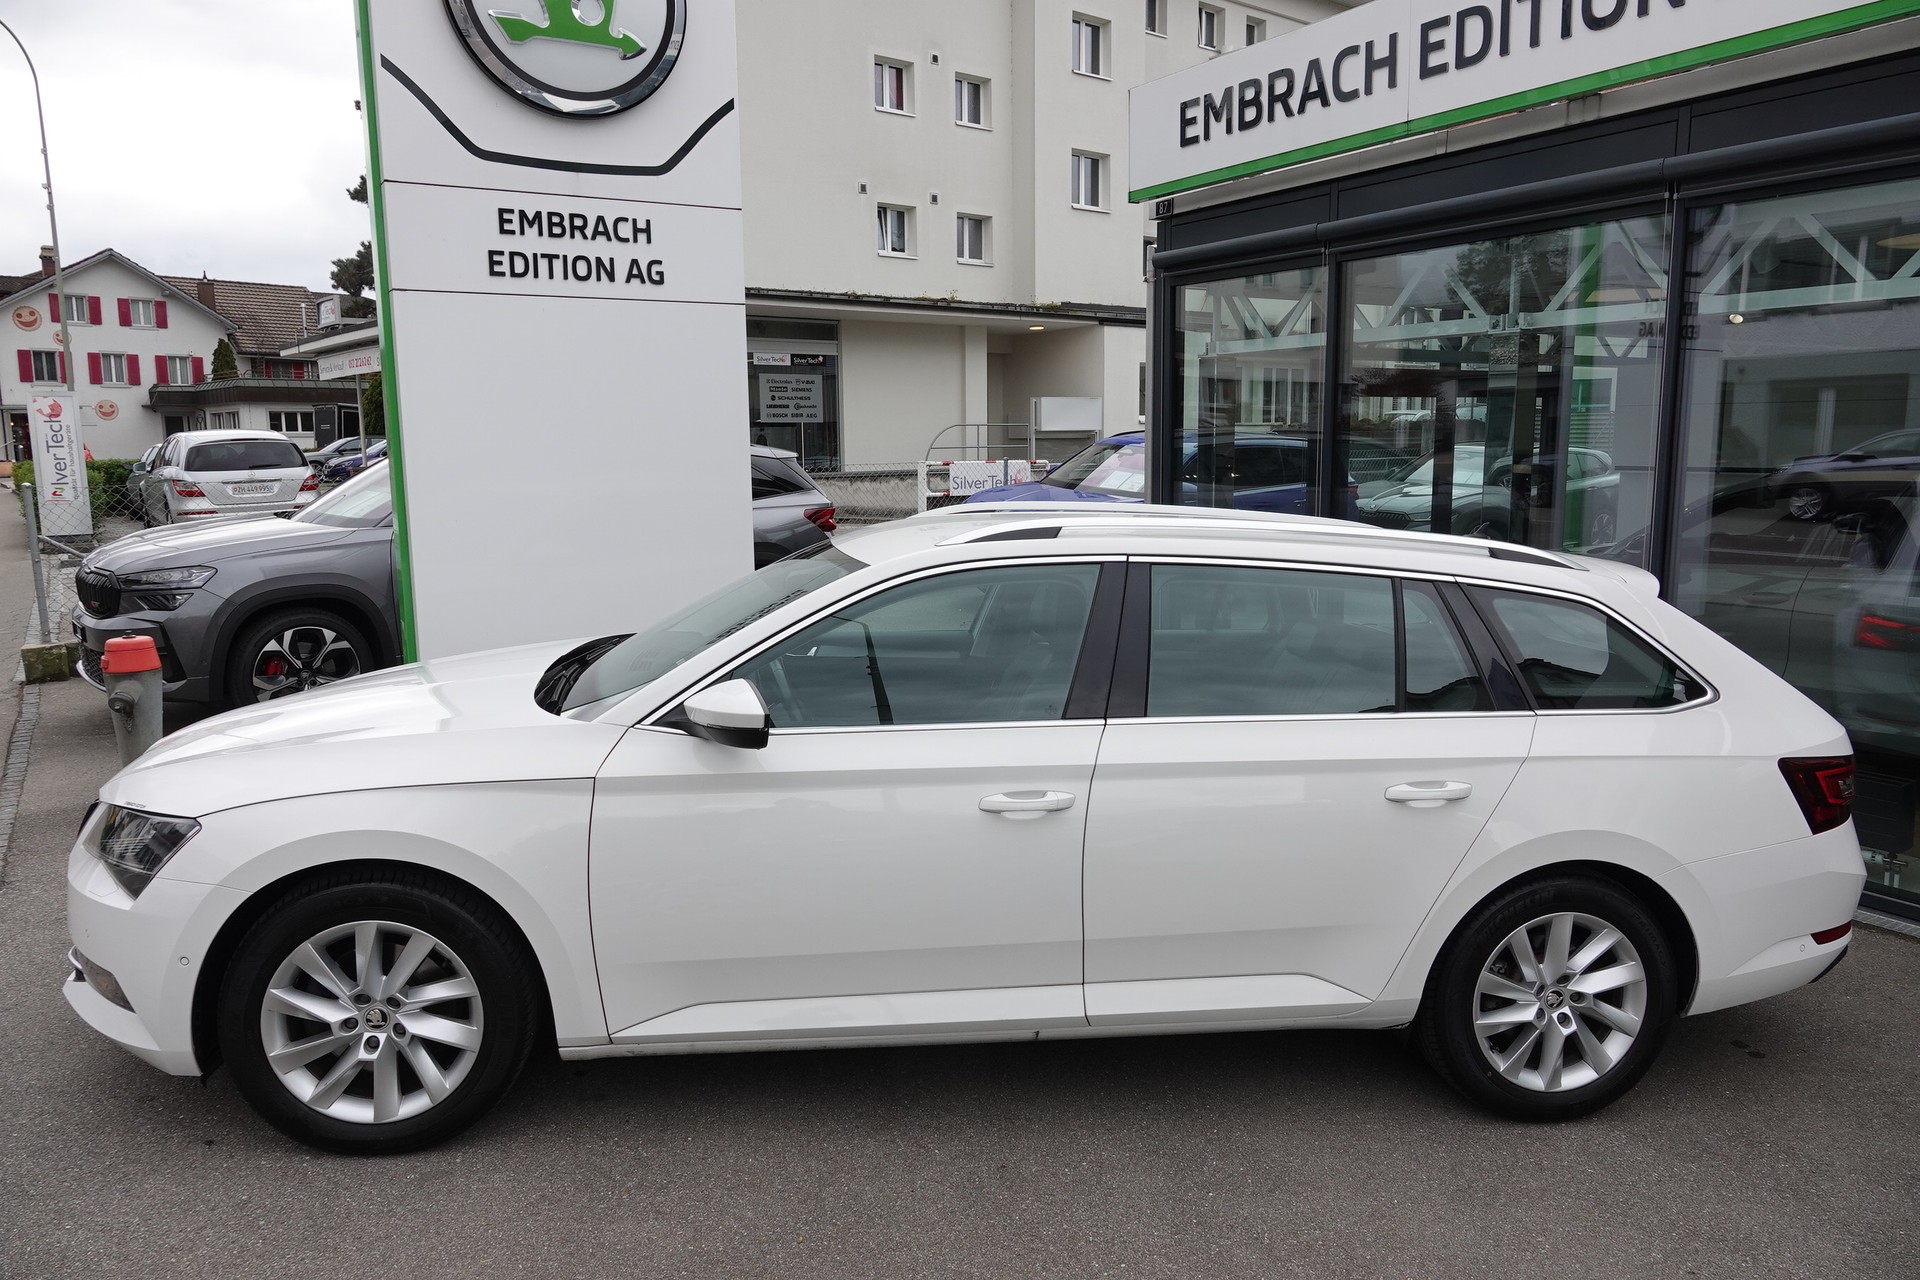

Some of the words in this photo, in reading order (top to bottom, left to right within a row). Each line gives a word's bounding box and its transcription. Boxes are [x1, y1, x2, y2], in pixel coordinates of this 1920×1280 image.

[1179, 32, 1399, 148] EMBRACH
[1419, 0, 1686, 80] EDITI
[497, 207, 652, 244] EMBRACH
[1158, 202, 1168, 214] 87
[488, 249, 616, 283] EDITION
[625, 258, 665, 285] AG
[952, 475, 1016, 490] SilverTeh
